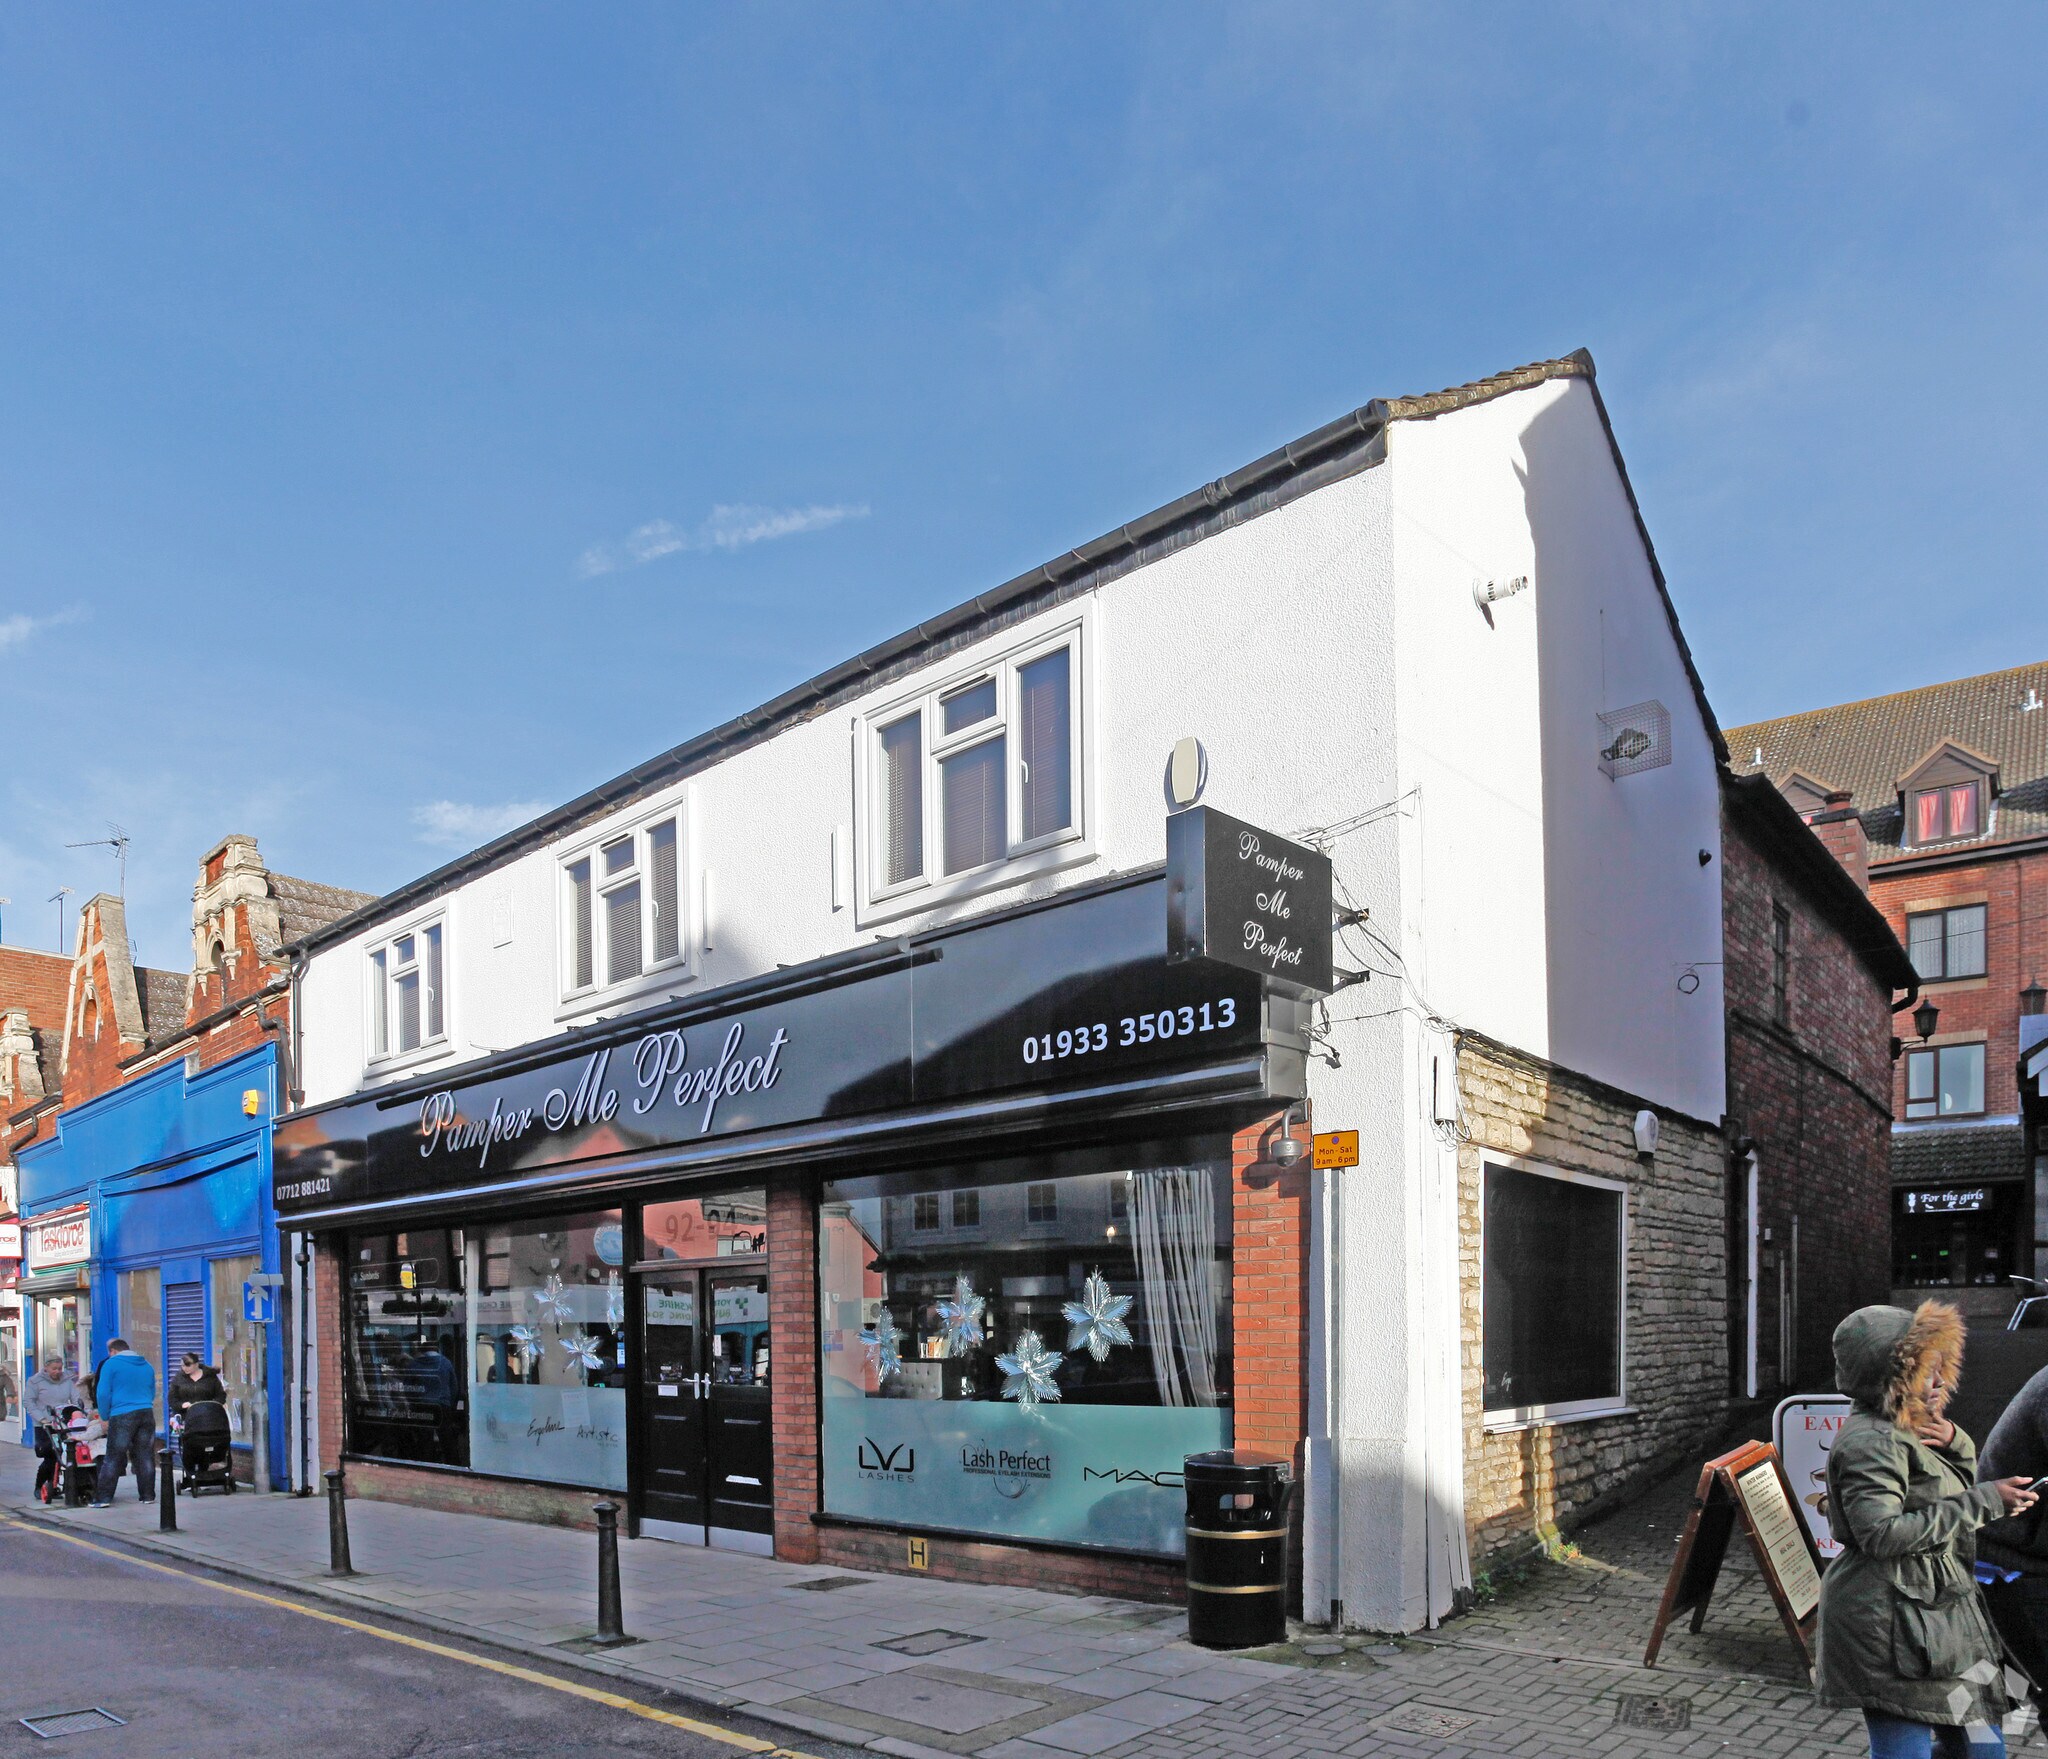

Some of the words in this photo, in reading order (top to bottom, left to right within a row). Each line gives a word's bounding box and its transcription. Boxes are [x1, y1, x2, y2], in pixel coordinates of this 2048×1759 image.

[1239, 831, 1303, 882] Pamper
[1256, 889, 1291, 919] Me
[1243, 921, 1303, 969] Perfect
[1022, 1023, 1108, 1064] 01933
[1119, 998, 1237, 1047] 350313
[420, 1090, 532, 1169] Pamper
[544, 1048, 620, 1131] Me
[633, 1022, 791, 1133] Perfect
[1340, 1146, 1353, 1154] Sat
[276, 1183, 300, 1200] 07712
[301, 1177, 331, 1197] 881421
[1920, 1193, 1940, 1203] For
[1942, 1190, 1958, 1202] the
[1959, 1188, 1984, 1205] girls
[40, 1221, 84, 1253] Taskforce
[962, 1448, 995, 1468] Lash
[999, 1450, 1051, 1472] Perfect
[963, 1467, 997, 1476] PROFESSIONAL
[998, 1469, 1020, 1477] EYELASH
[1020, 1471, 1052, 1479] EXTENSIONS
[858, 1471, 915, 1483] LASHES
[910, 1540, 925, 1567] H
